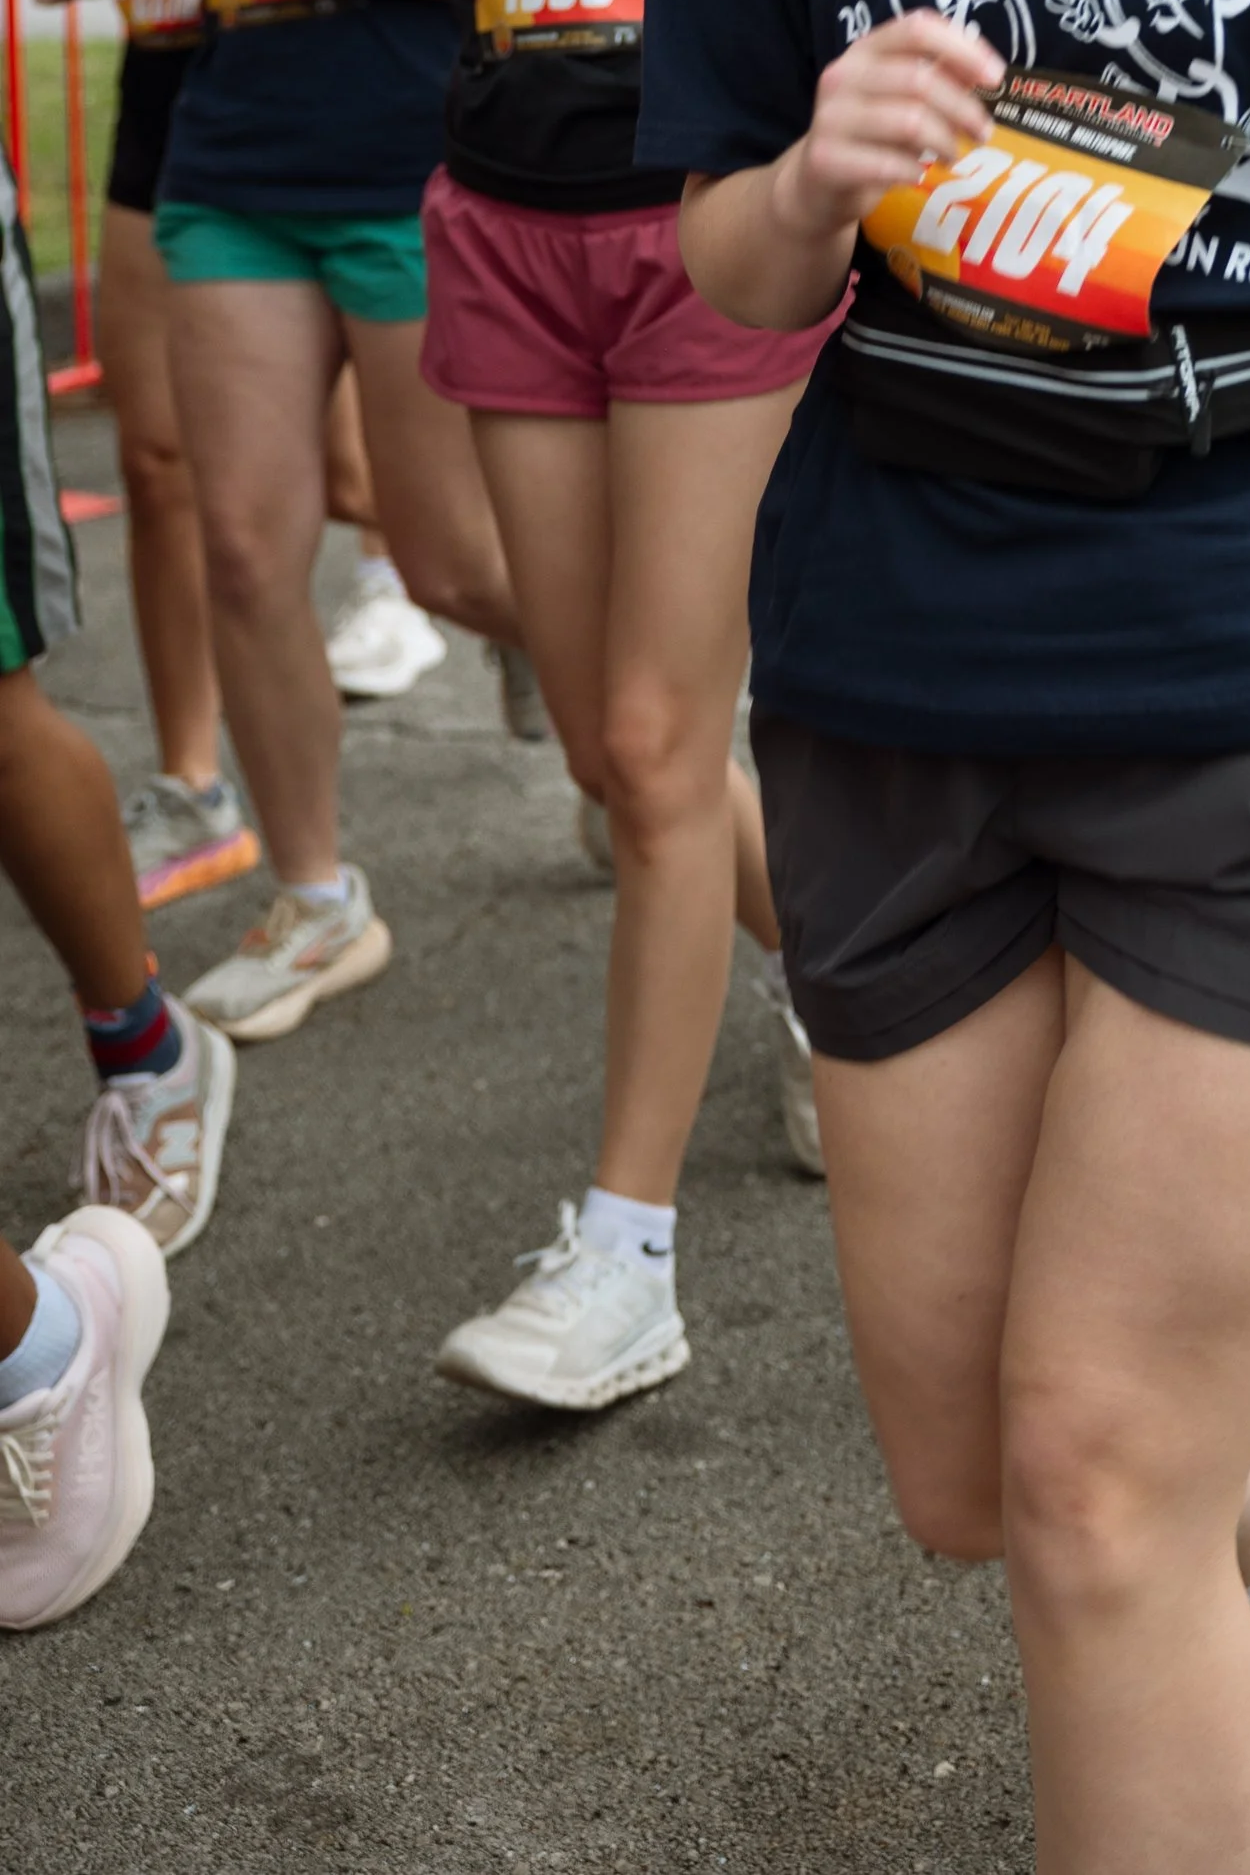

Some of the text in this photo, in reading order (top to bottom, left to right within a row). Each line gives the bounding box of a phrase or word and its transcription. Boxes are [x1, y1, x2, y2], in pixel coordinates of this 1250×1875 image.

[1009, 75, 1175, 139] HEARTLAND
[911, 146, 1135, 297] 2104
[1163, 230, 1219, 275] UN
